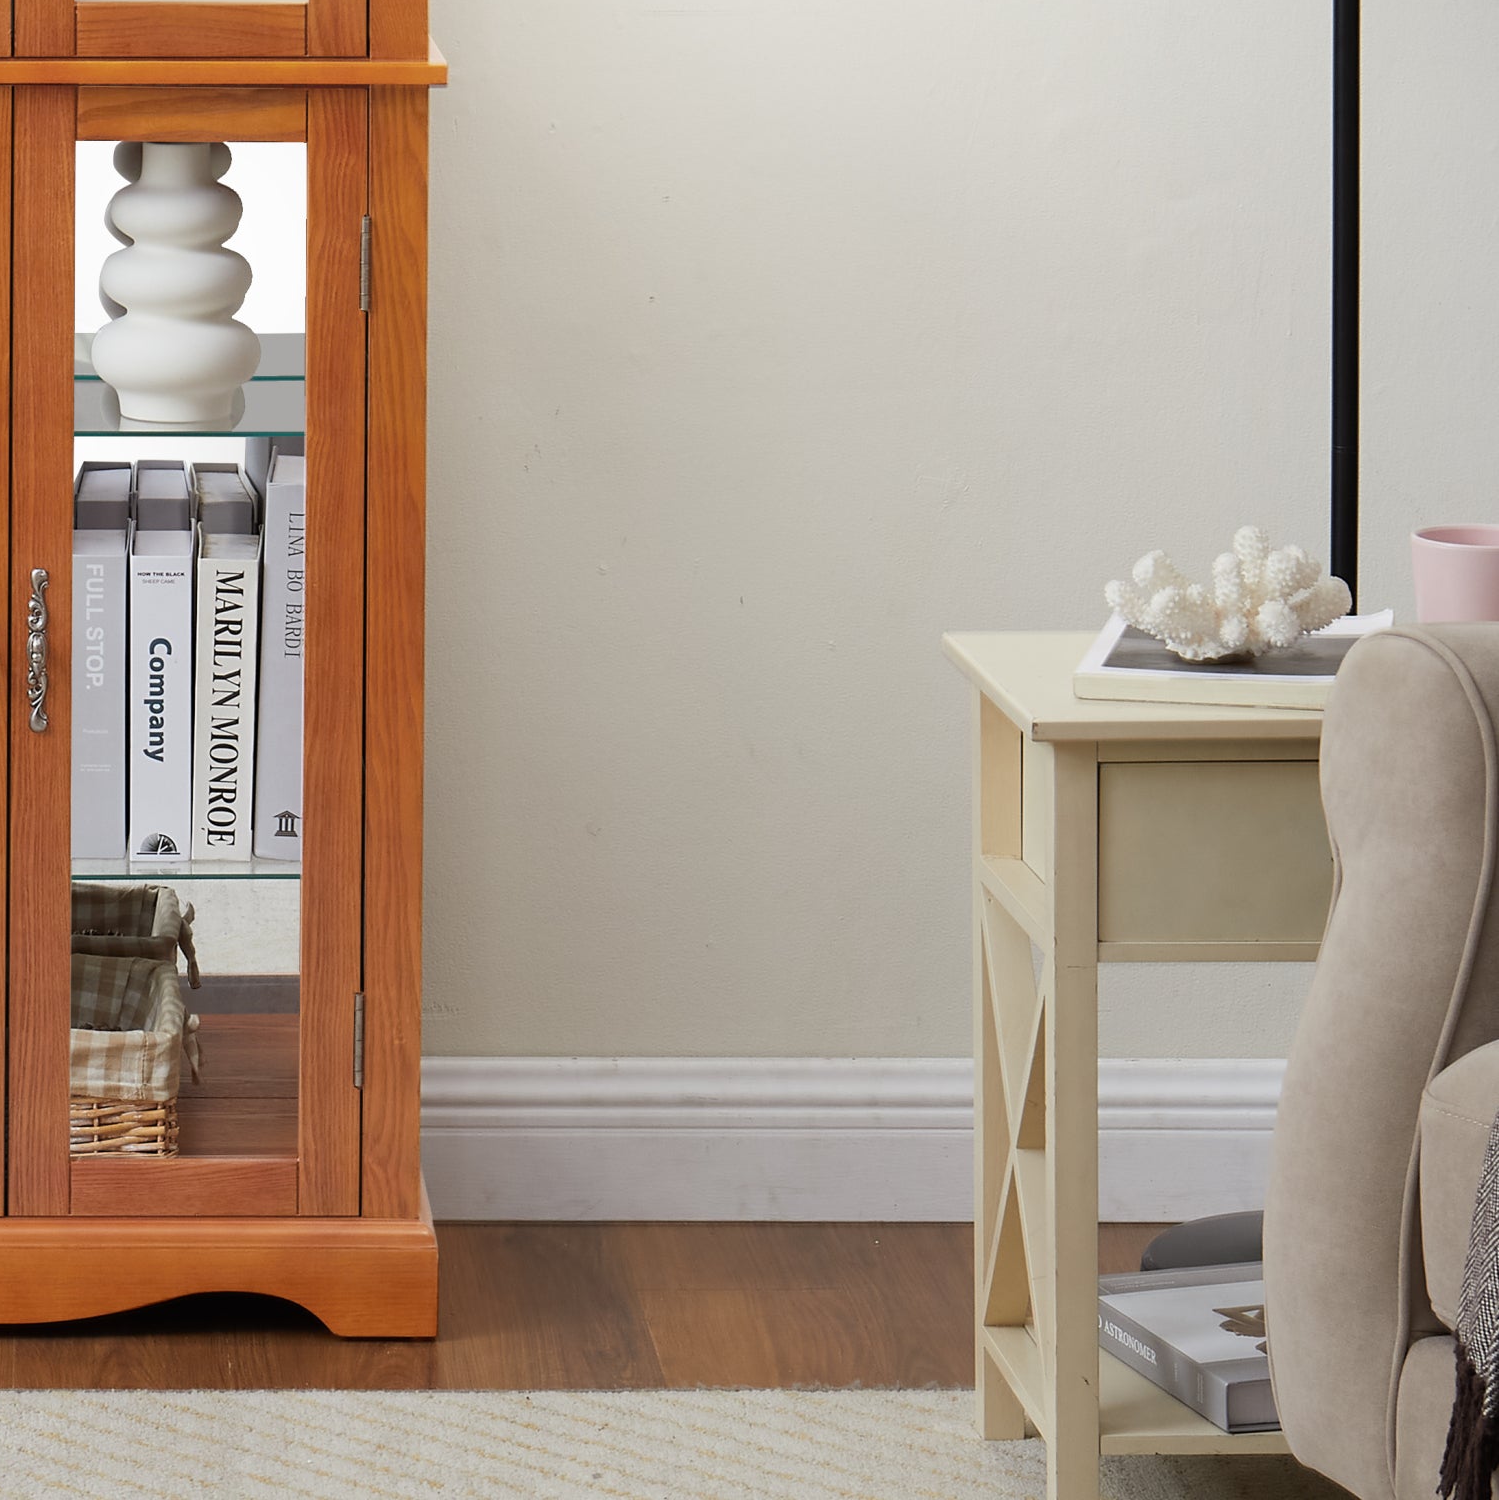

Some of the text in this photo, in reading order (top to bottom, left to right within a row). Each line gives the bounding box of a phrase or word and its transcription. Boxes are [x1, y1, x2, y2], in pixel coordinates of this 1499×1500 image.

[86, 564, 104, 690] FULL STOP.
[284, 512, 305, 658] LINA BO BARDI
[143, 637, 173, 763] Company
[206, 569, 245, 847] MARILYN MONROE
[1103, 1319, 1157, 1365] ASTRONOMER
